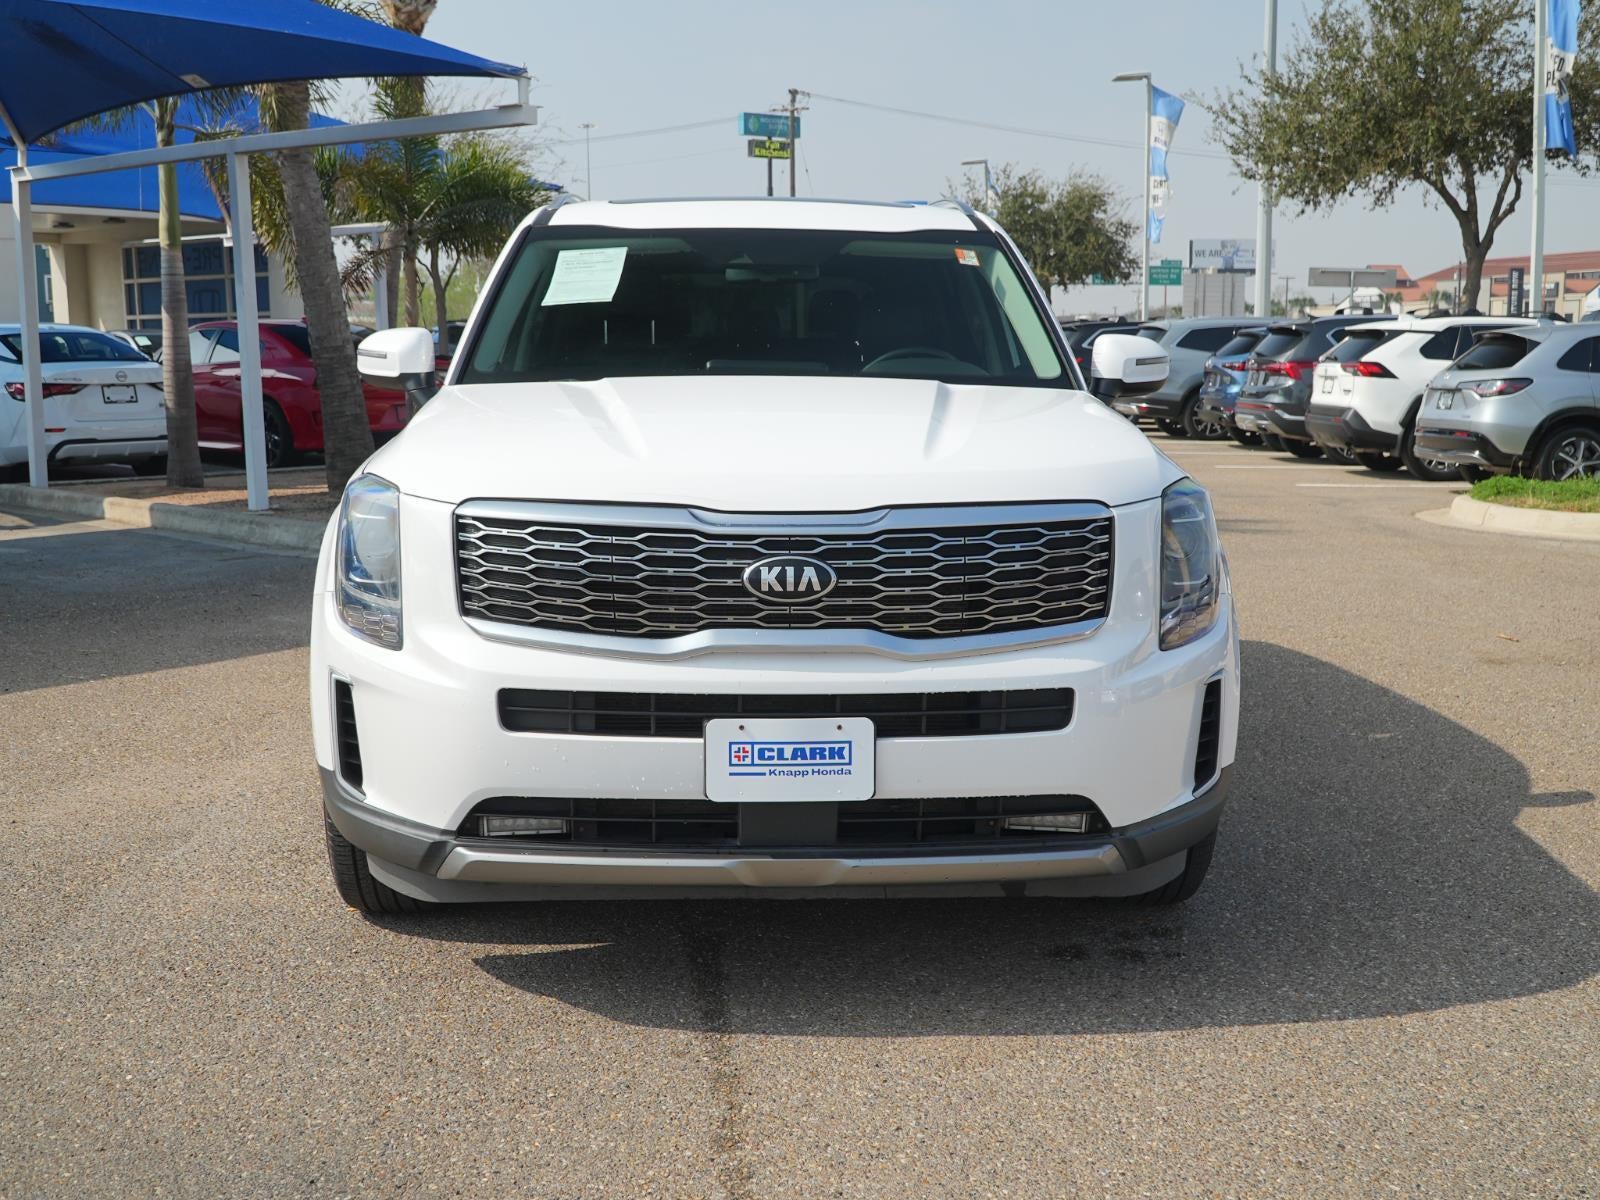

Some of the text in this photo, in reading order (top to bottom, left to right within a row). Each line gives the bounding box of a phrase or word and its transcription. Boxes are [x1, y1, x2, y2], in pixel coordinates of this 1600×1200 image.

[1194, 249, 1207, 257] WE
[759, 566, 822, 592] KIA
[757, 746, 846, 761] CLARK
[768, 767, 852, 778] Knapp Honda
